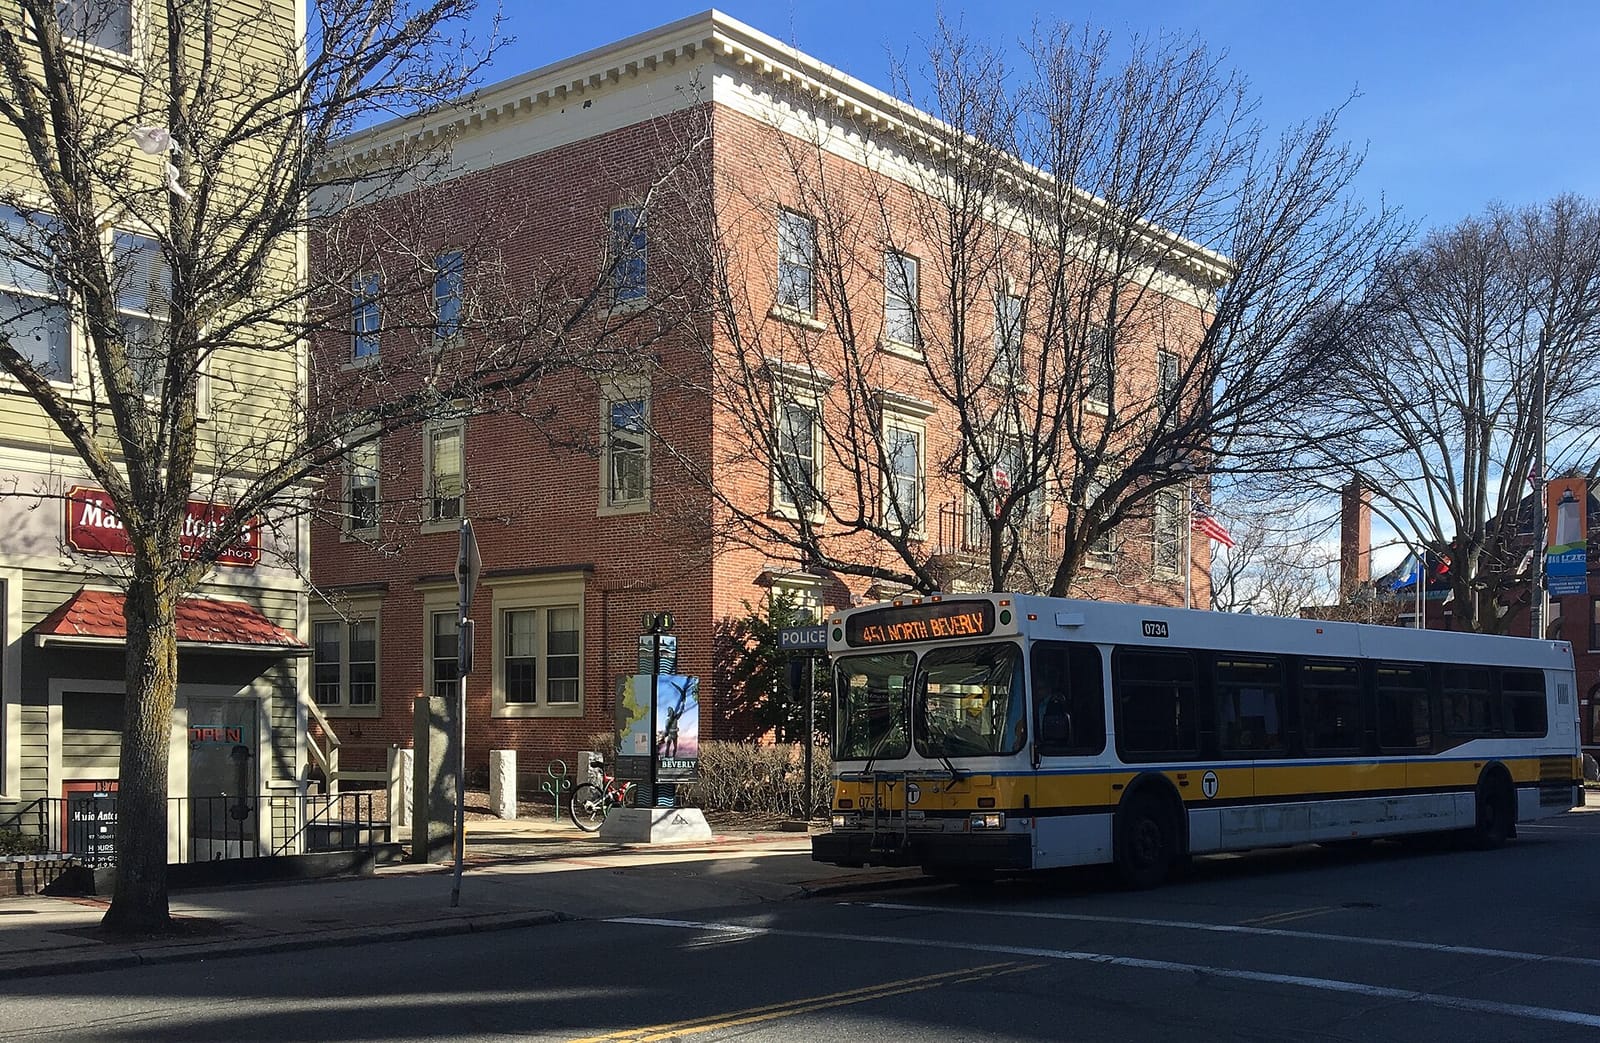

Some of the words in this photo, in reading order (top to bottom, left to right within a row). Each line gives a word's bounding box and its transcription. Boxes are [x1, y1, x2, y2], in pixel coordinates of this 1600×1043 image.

[863, 625, 886, 643] 451
[888, 620, 929, 641] NORTH
[930, 612, 984, 637] BEVERLY
[1144, 623, 1167, 636] 0734
[782, 630, 826, 645] POLICE
[662, 760, 696, 768] BEVERLY
